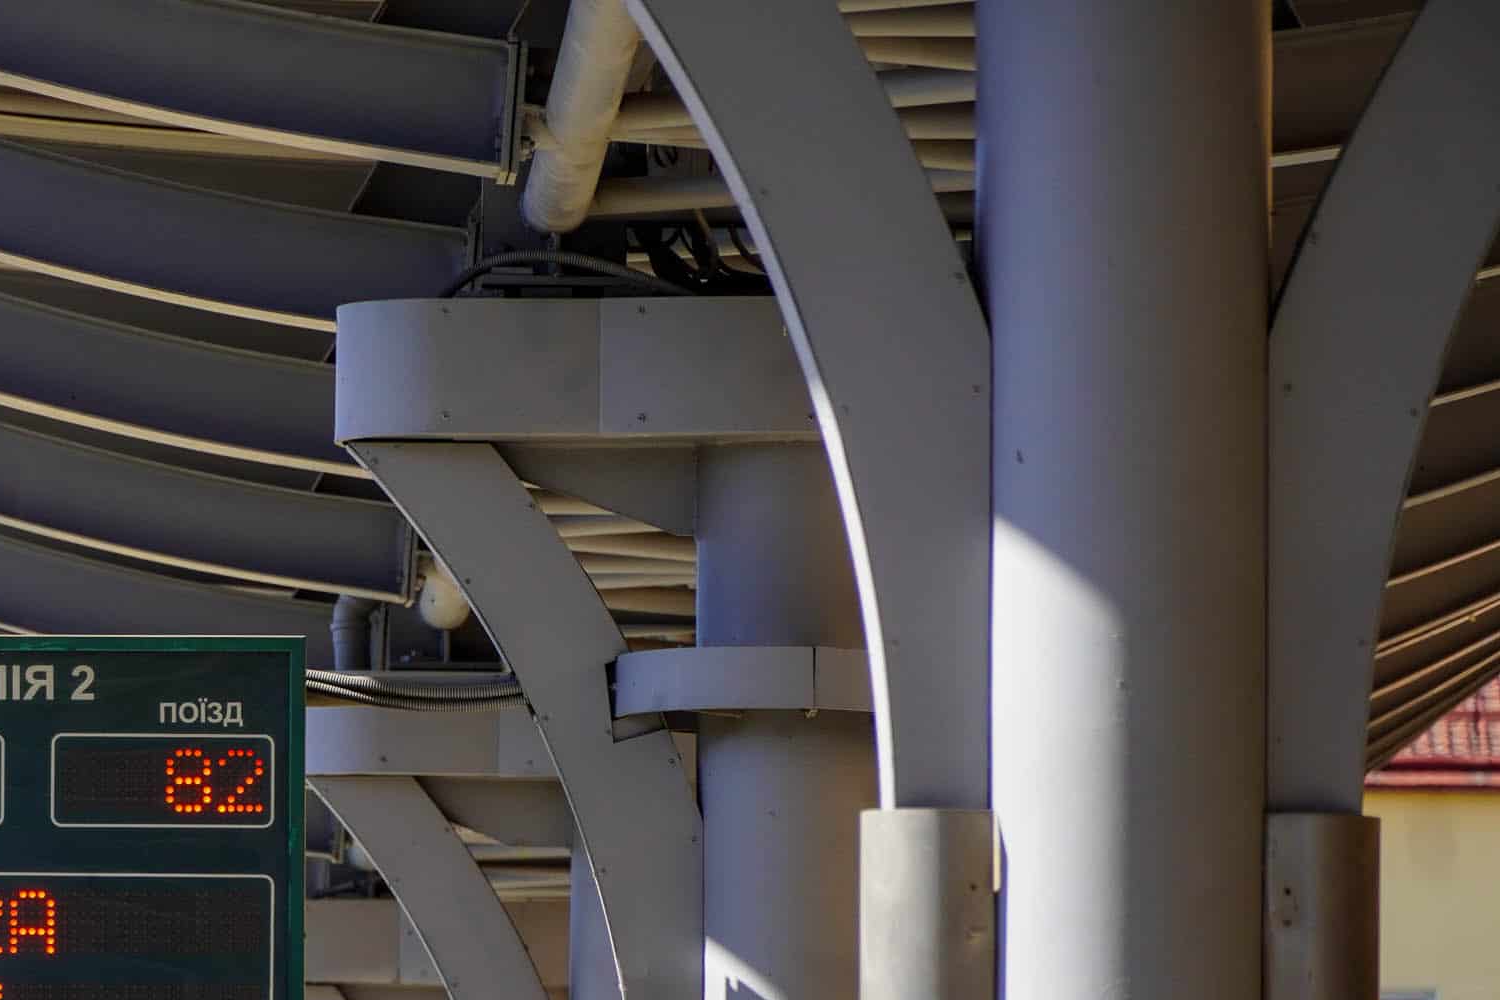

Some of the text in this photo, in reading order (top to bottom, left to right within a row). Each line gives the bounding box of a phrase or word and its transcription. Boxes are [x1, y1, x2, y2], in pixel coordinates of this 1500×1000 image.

[70, 664, 96, 701] 2
[158, 700, 245, 728] ПОЇЗД
[164, 747, 265, 814] 82
